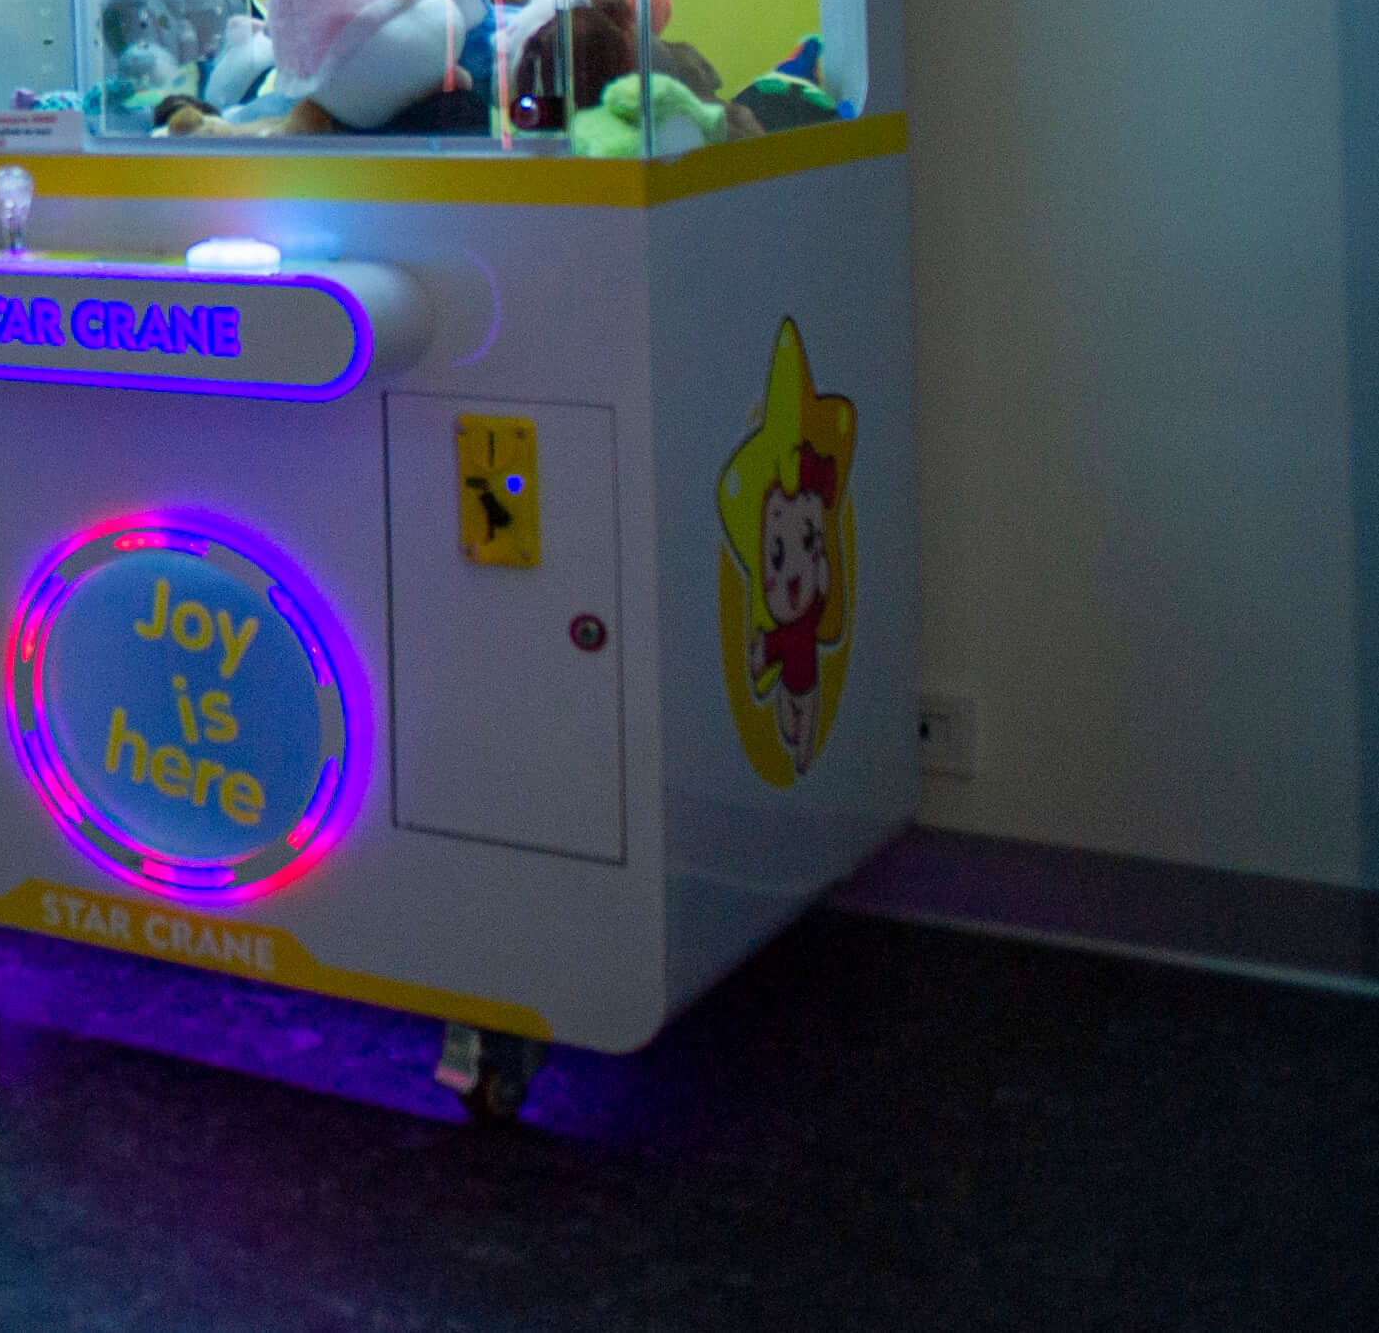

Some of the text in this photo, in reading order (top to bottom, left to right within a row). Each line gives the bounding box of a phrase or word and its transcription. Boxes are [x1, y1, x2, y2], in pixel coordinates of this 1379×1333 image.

[71, 298, 241, 358] CRANE
[134, 577, 259, 678] Joy
[172, 674, 238, 744] is
[105, 706, 265, 826] here
[42, 890, 275, 971] STAR CRANE
